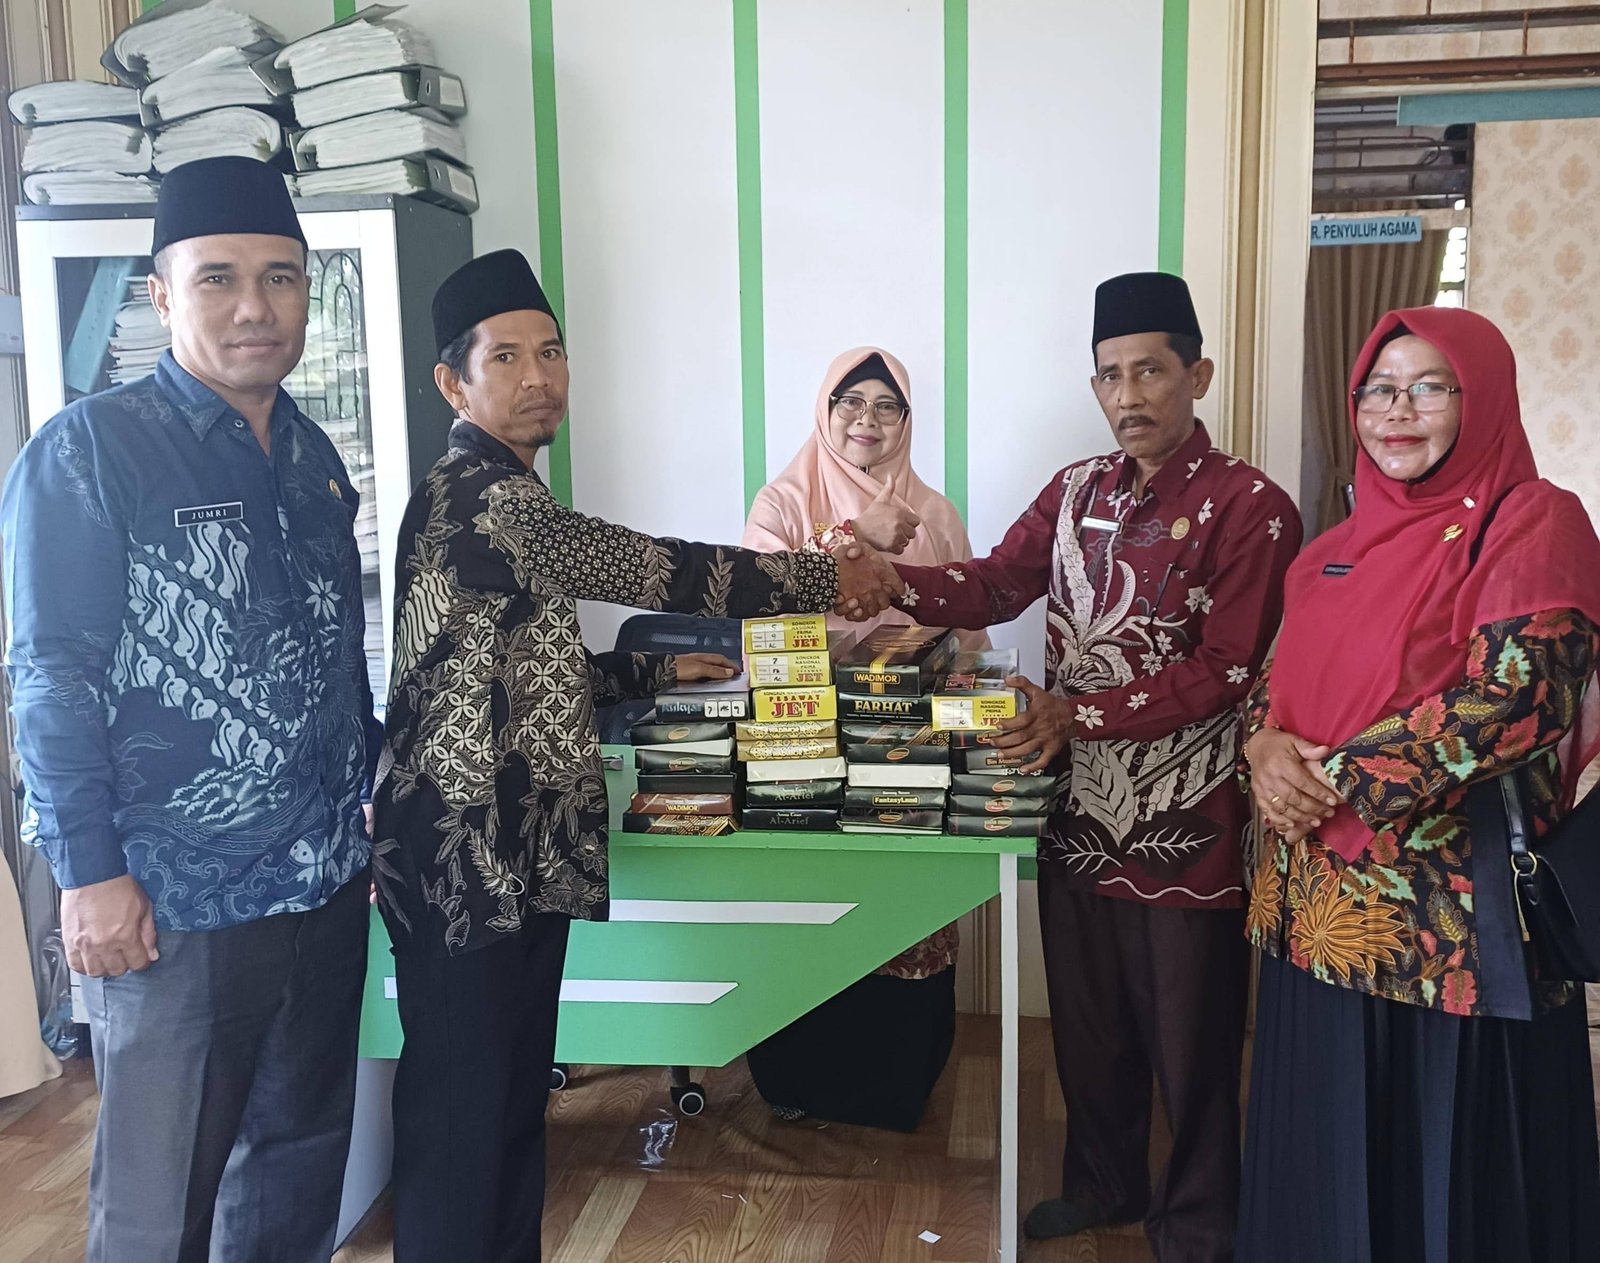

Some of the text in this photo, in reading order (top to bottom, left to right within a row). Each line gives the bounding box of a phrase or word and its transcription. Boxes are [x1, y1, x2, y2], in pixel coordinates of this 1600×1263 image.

[1312, 221, 1417, 239] R. PENYULUH AGAMA
[192, 509, 227, 520] JUMRI
[792, 638, 820, 648] JET
[796, 673, 823, 682] JET
[856, 673, 897, 683] WADIMOR
[771, 701, 820, 718] JET
[855, 700, 912, 712] FARHAT
[667, 804, 698, 812] WADIMOR
[769, 817, 810, 825] Al-Arief
